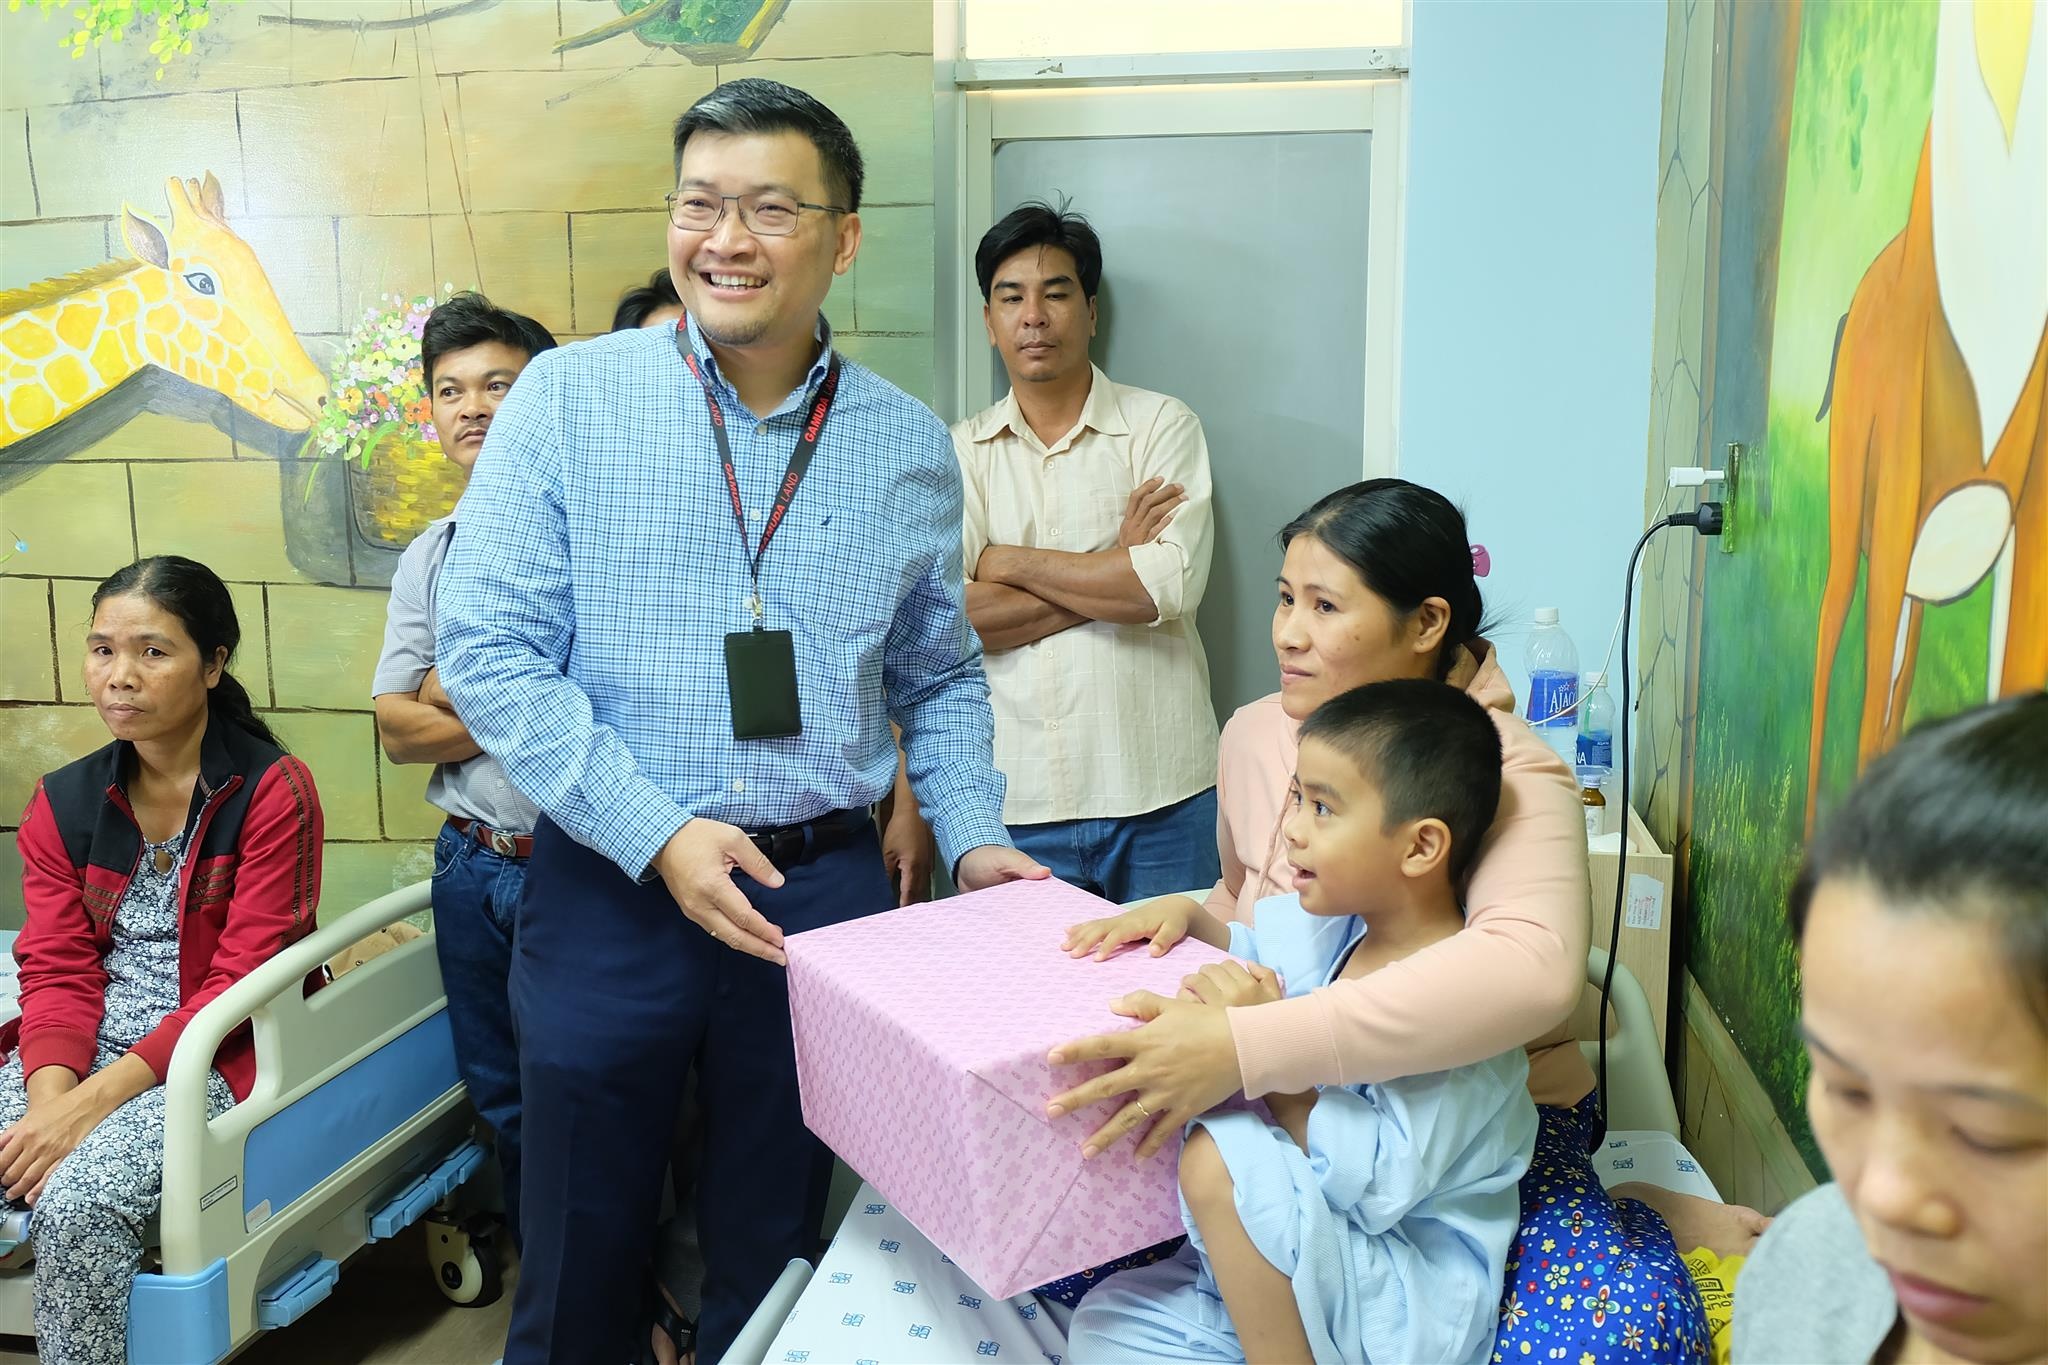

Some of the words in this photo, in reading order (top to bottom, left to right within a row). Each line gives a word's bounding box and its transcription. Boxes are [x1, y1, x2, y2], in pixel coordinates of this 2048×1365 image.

[708, 396, 723, 427] LAND
[804, 397, 829, 443] GAMUDA
[724, 463, 742, 516] GAMUDA
[780, 472, 799, 502] LAND
